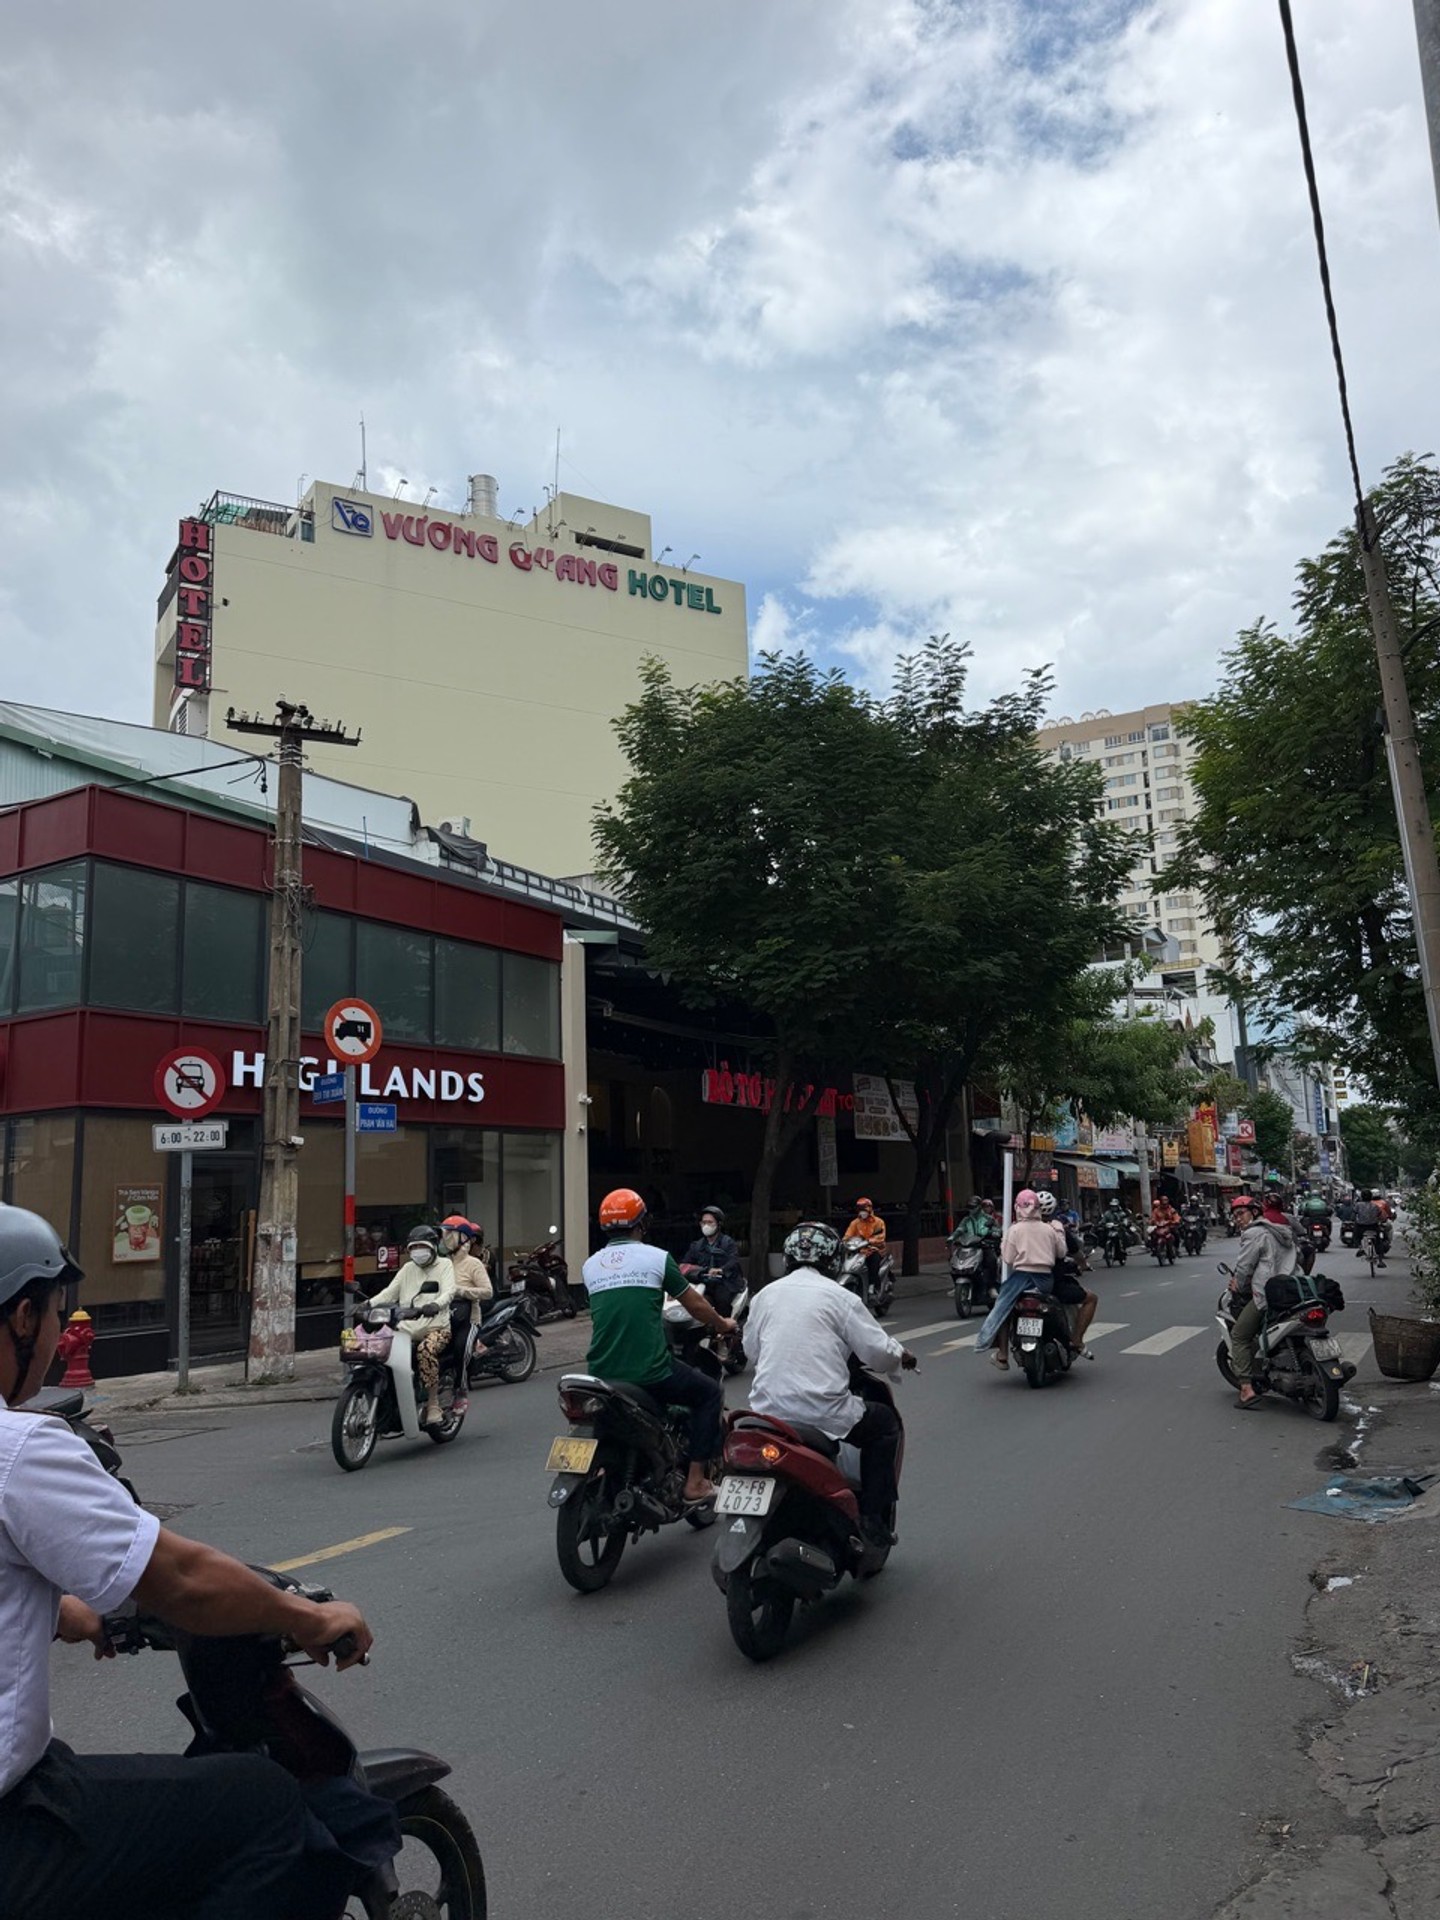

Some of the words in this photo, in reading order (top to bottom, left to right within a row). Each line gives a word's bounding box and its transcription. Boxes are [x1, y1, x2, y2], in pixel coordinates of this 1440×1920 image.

[380, 510, 498, 563] VƯƠNG
[628, 569, 722, 615] HOTEL
[179, 521, 209, 686] HOTEL
[232, 1050, 485, 1103] HGLANDS
[160, 1132, 182, 1145] 6:00
[193, 1130, 221, 1143] 22:00
[722, 1495, 762, 1512] 4073
[727, 1479, 766, 1495] 52-F8
